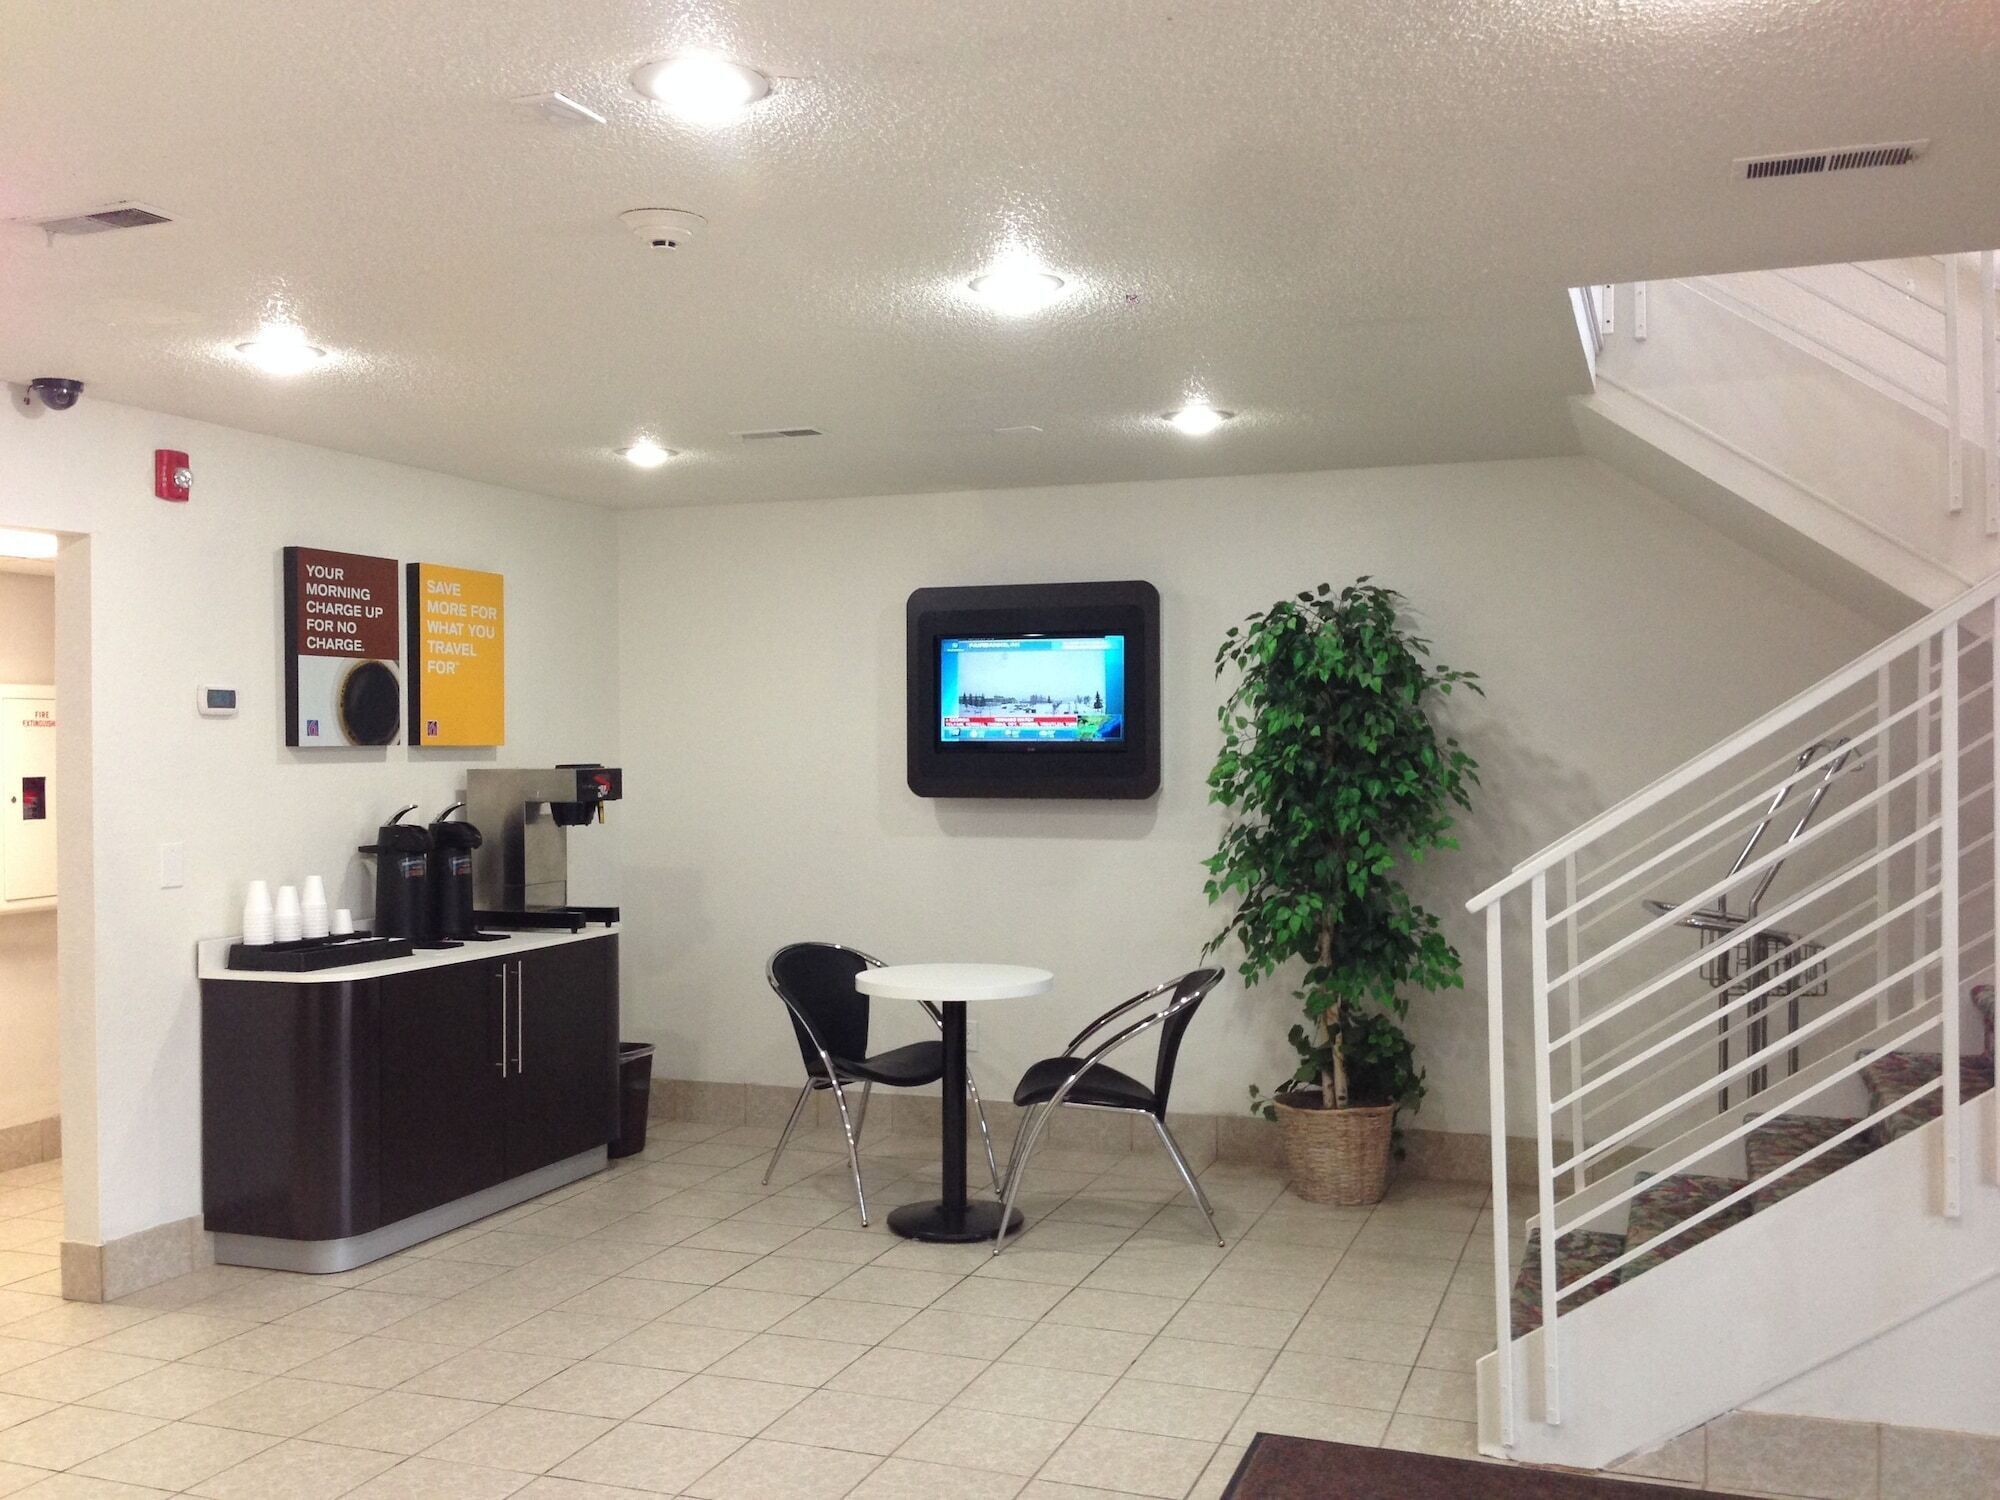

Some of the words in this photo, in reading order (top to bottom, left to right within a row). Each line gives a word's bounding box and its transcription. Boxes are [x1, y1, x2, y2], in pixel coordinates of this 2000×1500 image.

[306, 564, 344, 580] YOUR
[306, 583, 371, 600] MORNING
[427, 580, 461, 596] SAVE
[306, 601, 362, 617] CHARGE
[365, 606, 384, 618] UP
[427, 600, 467, 617] MORE
[471, 605, 497, 619] FOR
[306, 618, 334, 632] FOR
[337, 621, 357, 634] NO
[427, 620, 464, 636] WHAT
[468, 624, 496, 639] YOU
[306, 636, 365, 652] CHARGE.
[427, 640, 477, 657] TRAVEL
